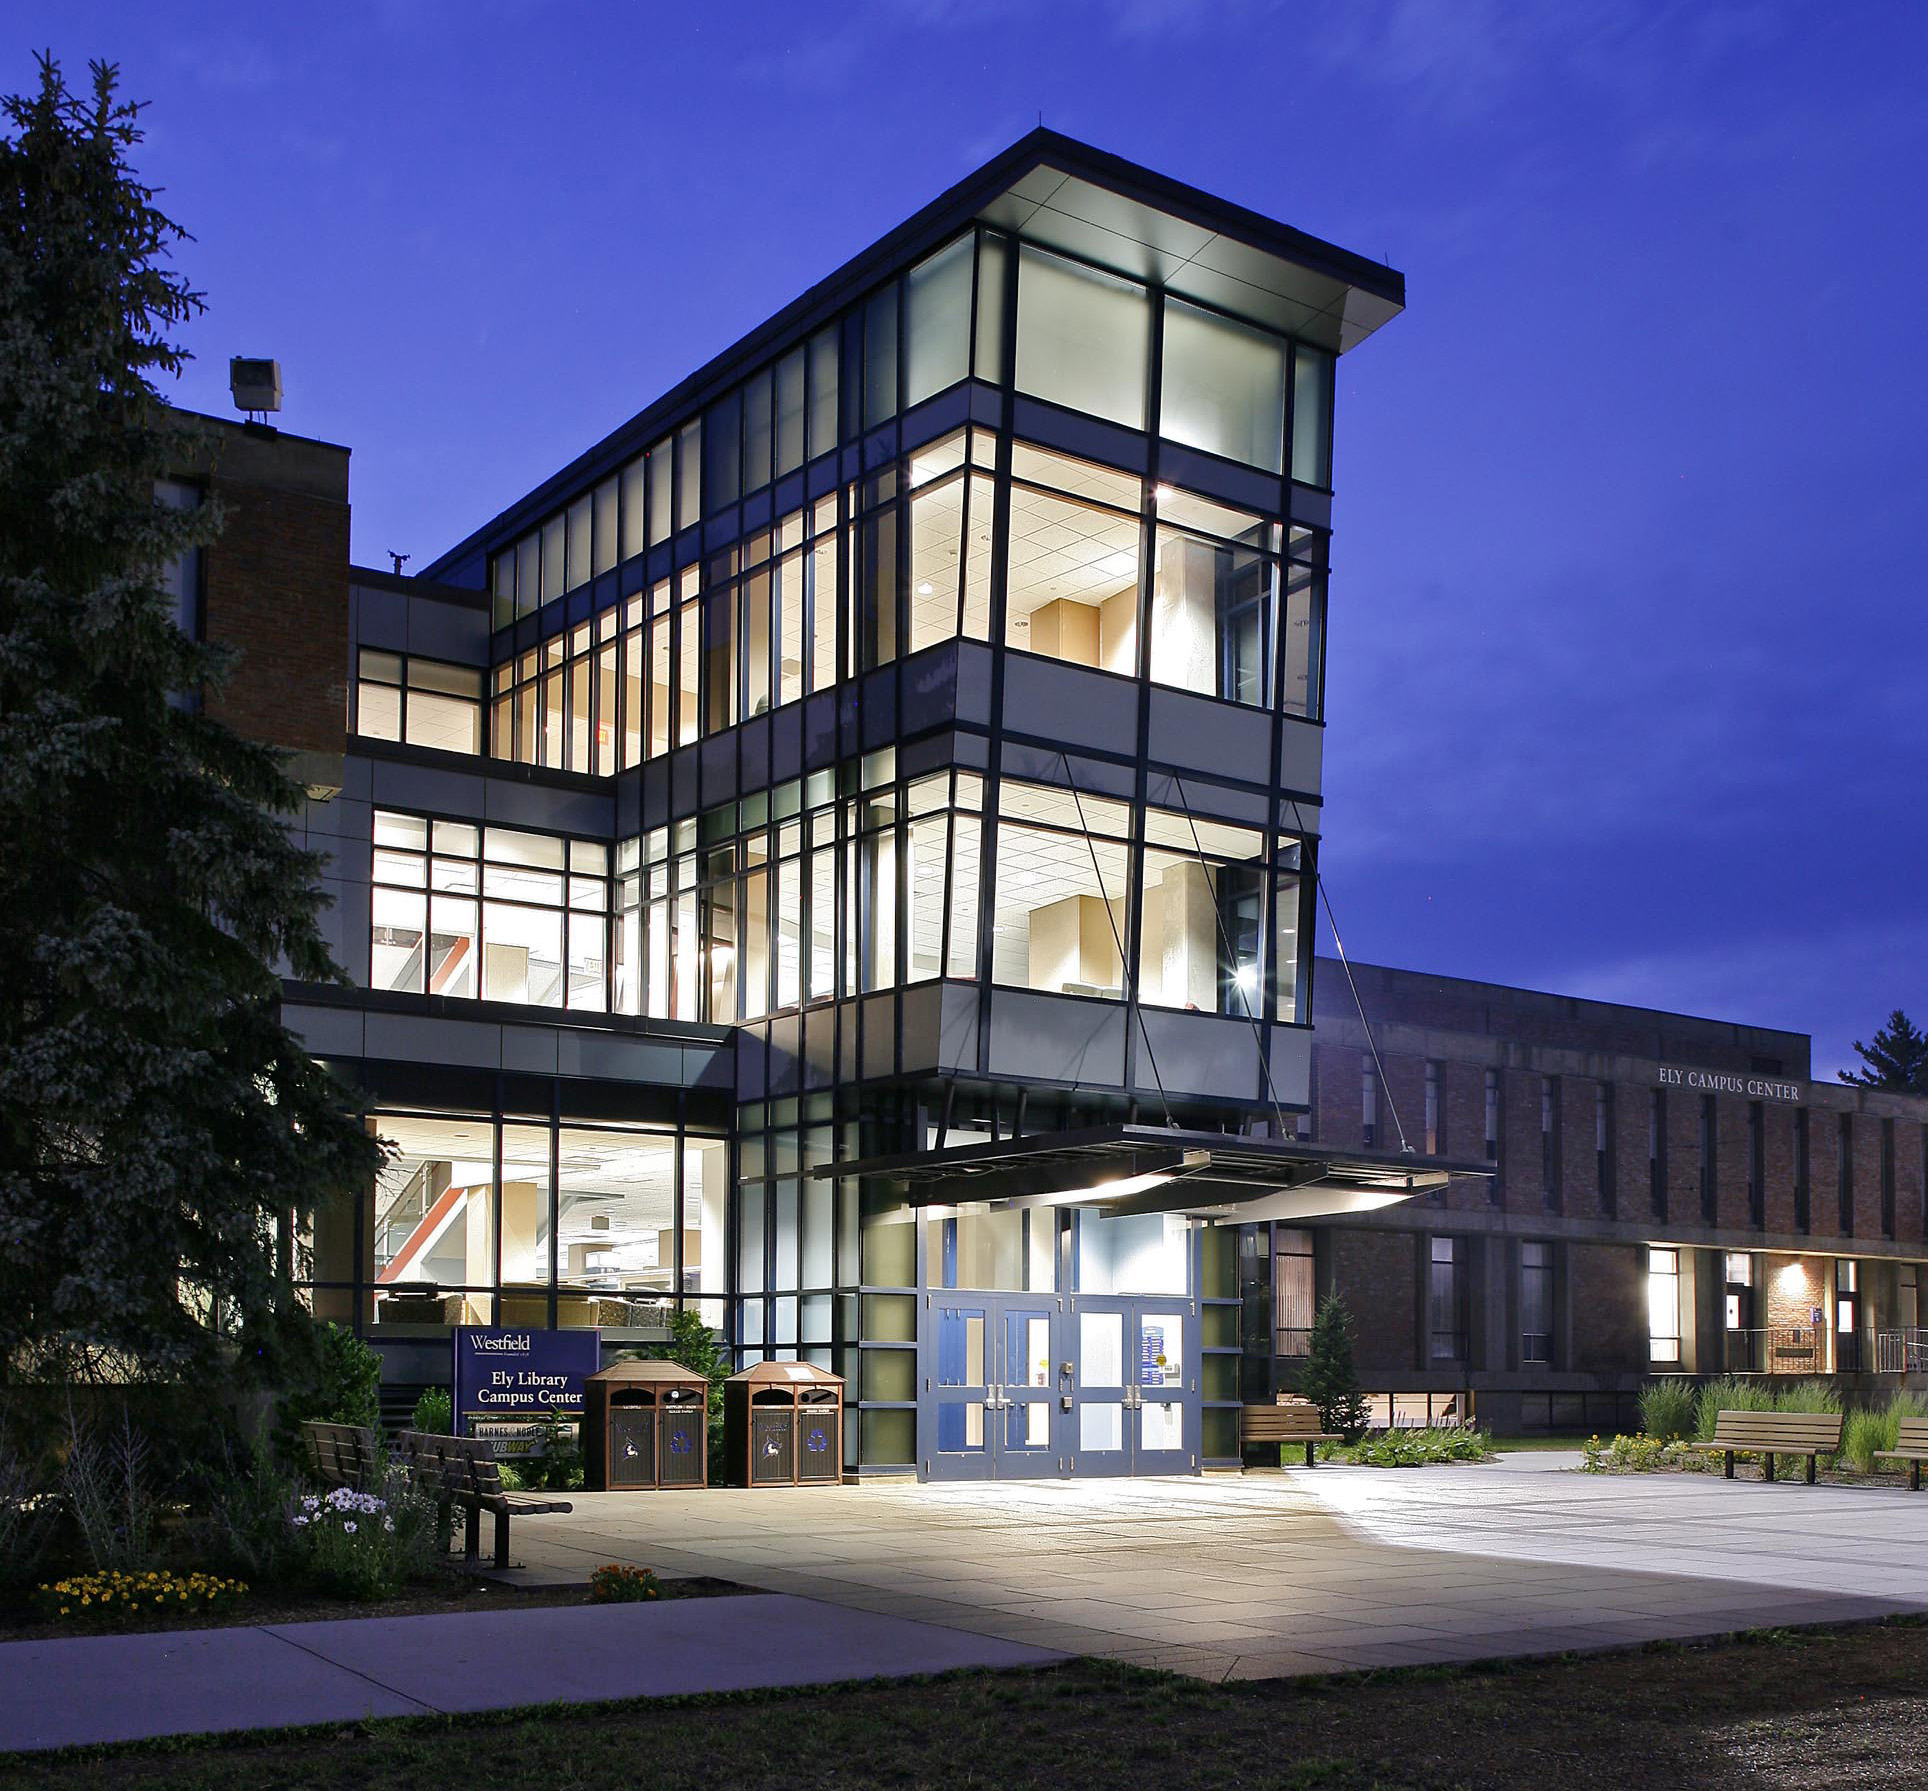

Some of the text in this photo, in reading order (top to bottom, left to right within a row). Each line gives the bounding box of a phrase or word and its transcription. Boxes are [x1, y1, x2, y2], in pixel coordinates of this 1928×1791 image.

[1659, 1067, 1799, 1100] ELY CAMPUS CENTER
[470, 1334, 530, 1350] Westfield
[491, 1371, 568, 1389] Ely Library
[478, 1389, 582, 1407] Campus Center
[479, 1427, 508, 1438] BARNES
[490, 1440, 537, 1453] UBWAY
